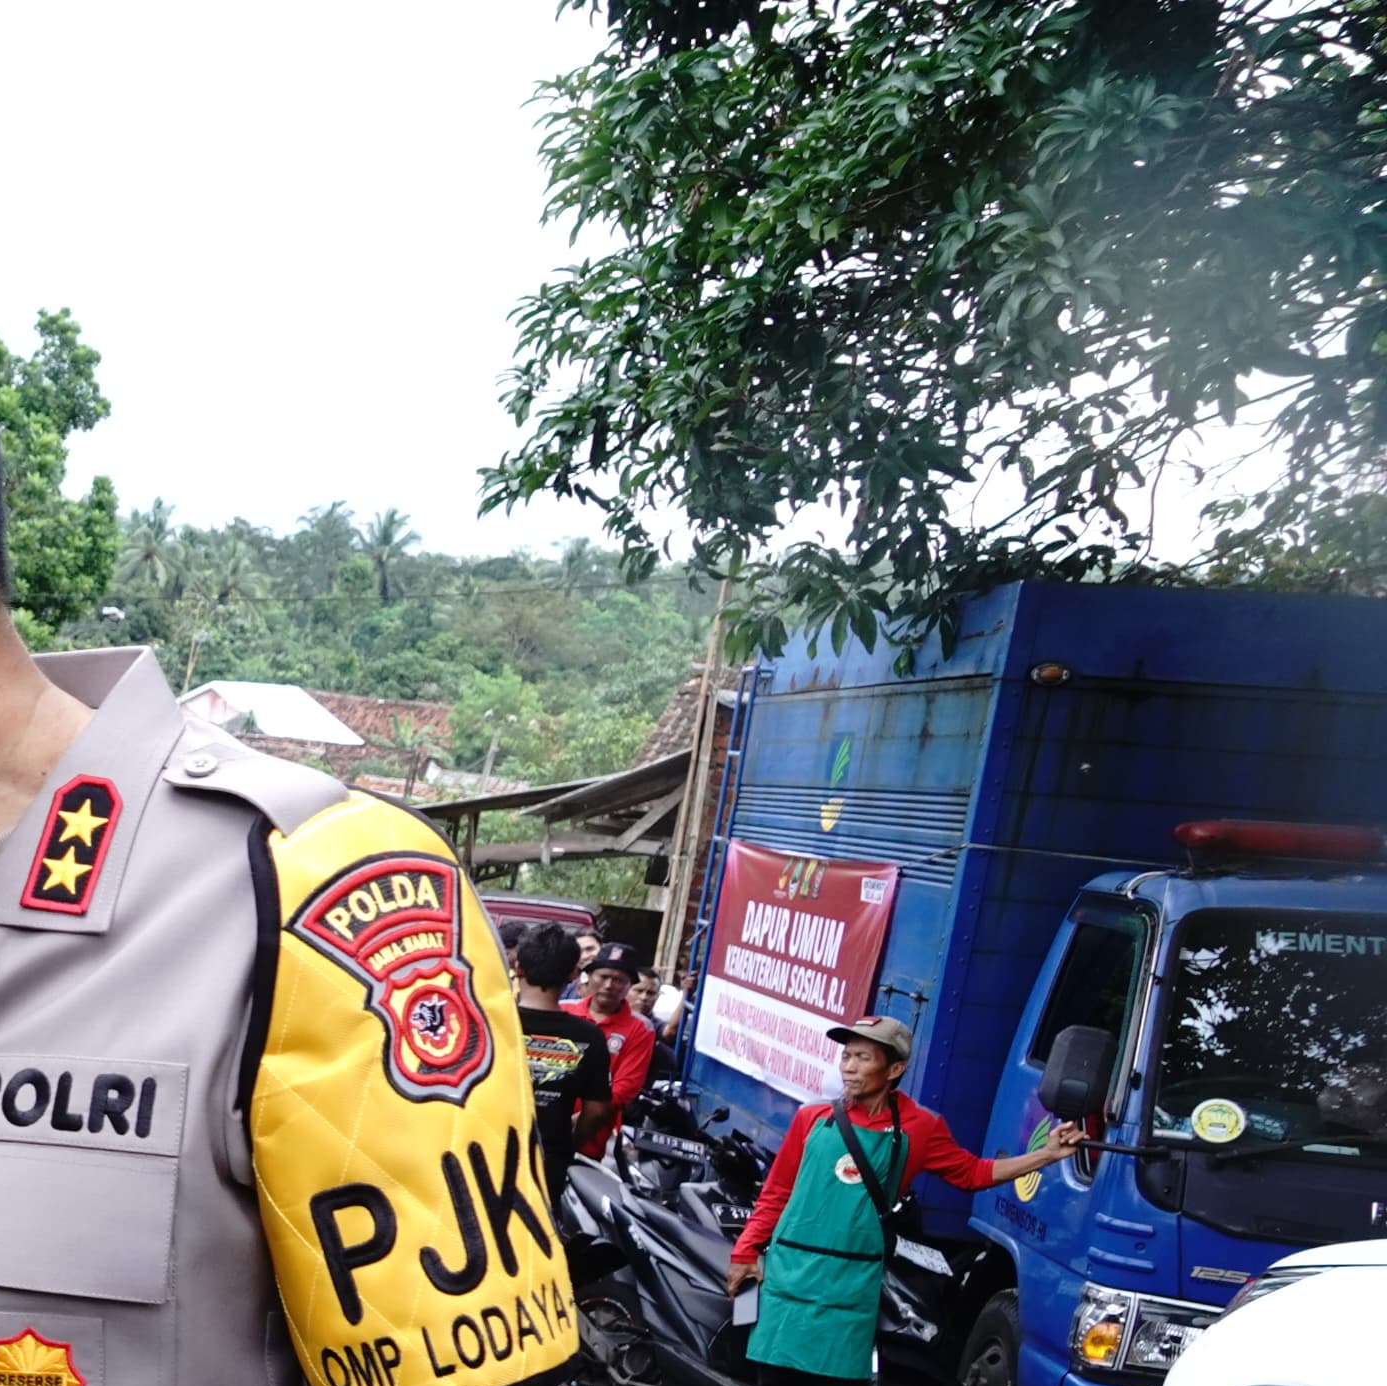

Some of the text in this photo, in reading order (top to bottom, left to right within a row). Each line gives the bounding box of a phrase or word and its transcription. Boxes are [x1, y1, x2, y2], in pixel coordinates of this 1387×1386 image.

[325, 875, 440, 942] POLDA
[742, 900, 845, 969] DAPUR UMUM
[368, 932, 444, 971] JAWA BARAT
[724, 944, 791, 995] KEMENTERIAN
[787, 963, 827, 1009] SOSIAL
